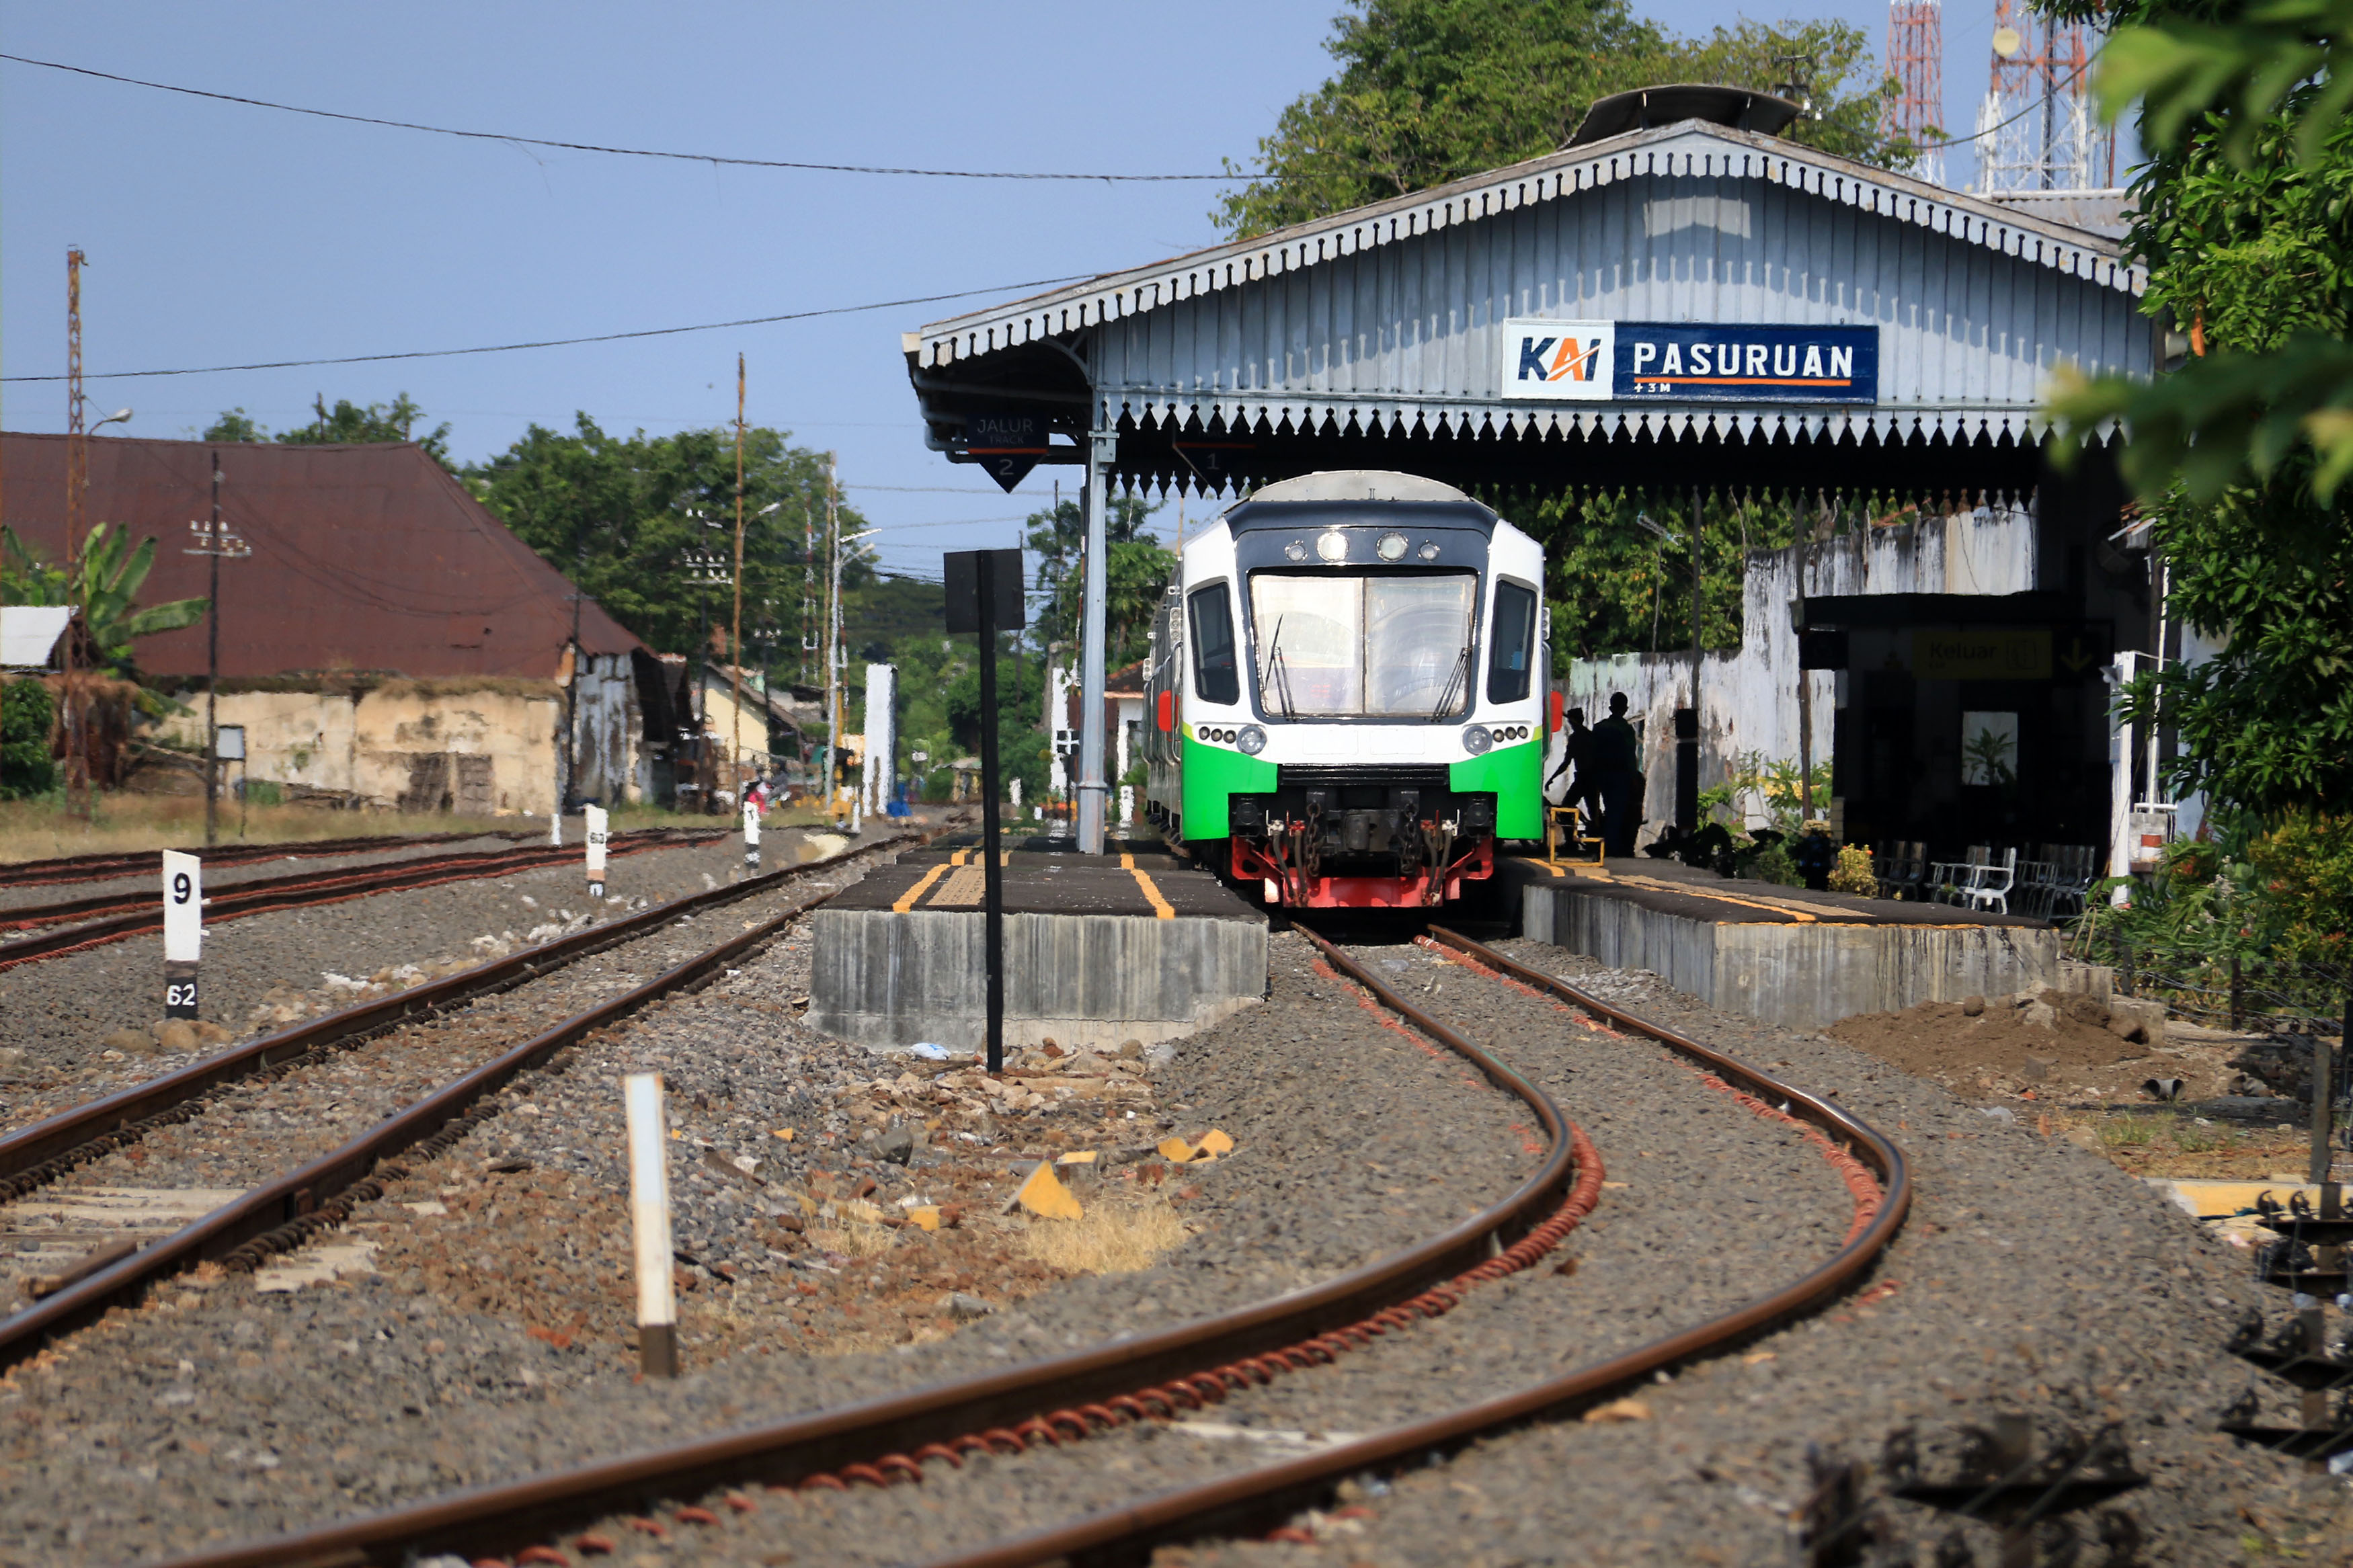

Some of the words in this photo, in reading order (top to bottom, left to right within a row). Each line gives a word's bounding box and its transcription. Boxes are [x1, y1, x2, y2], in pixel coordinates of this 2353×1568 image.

[1517, 336, 1601, 382] KAI
[1634, 341, 1853, 378] PASURUAN
[977, 418, 1033, 434] JALUR
[989, 435, 1025, 445] TRACK
[999, 458, 1014, 476] 2
[1206, 452, 1220, 470] 1
[1930, 639, 1997, 660] Keluar
[173, 872, 192, 905] 9
[166, 983, 196, 1007] 62
